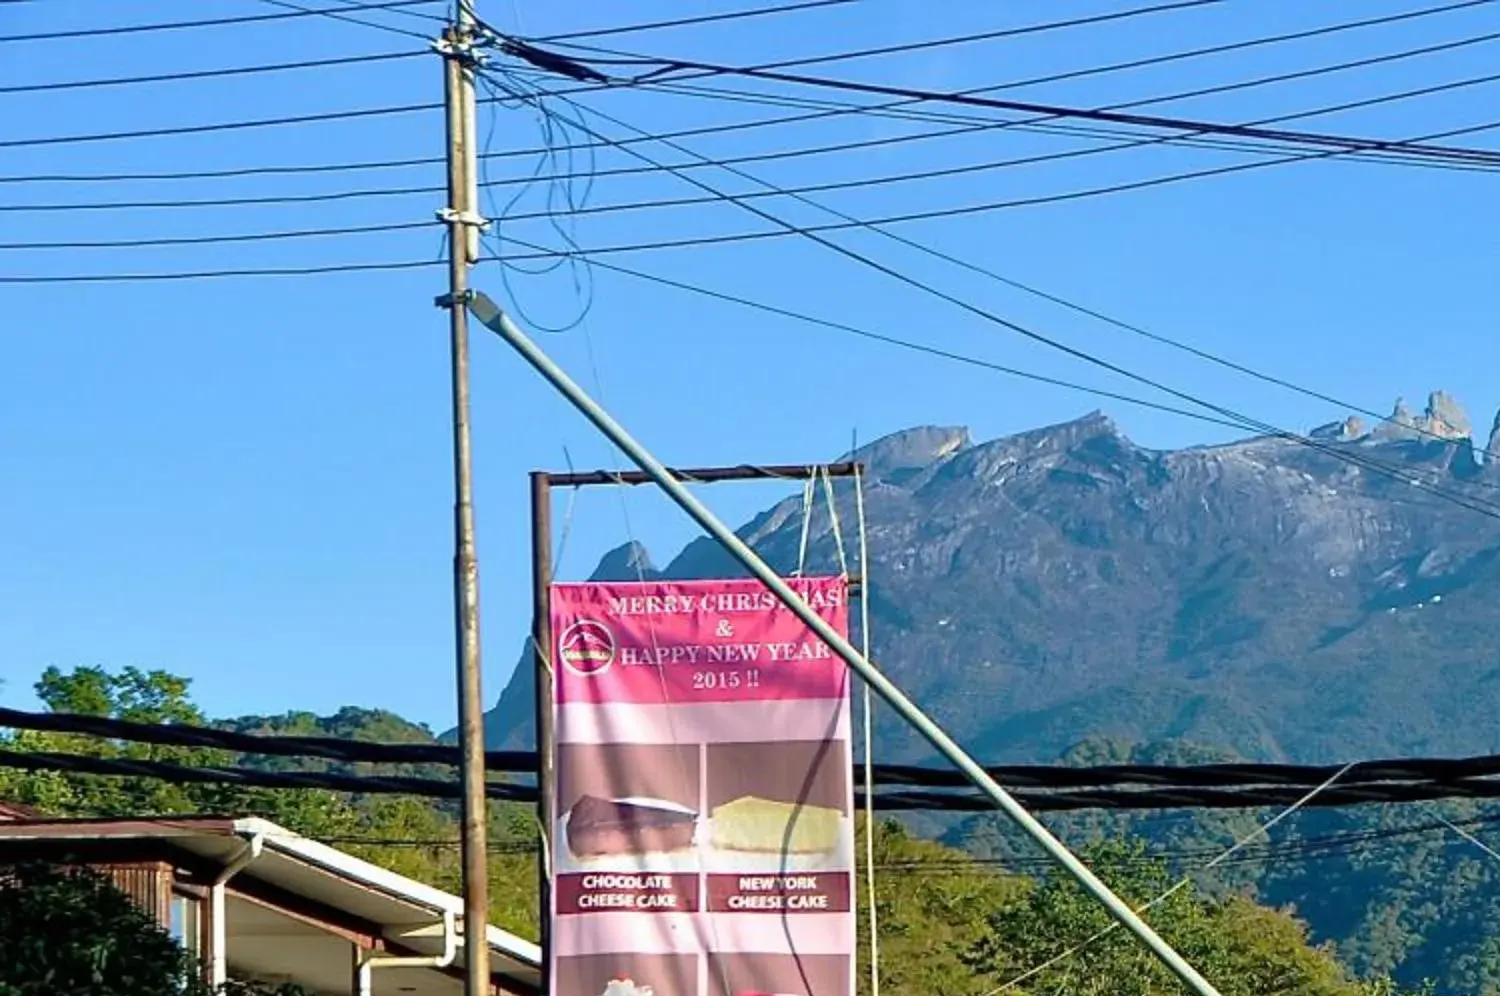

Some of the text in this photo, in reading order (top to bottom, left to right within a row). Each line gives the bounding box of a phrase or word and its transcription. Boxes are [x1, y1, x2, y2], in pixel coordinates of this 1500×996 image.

[608, 586, 842, 616] MERRY CHRISAS
[715, 619, 734, 637] &
[620, 641, 832, 666] HAPPY NEW YEAR
[692, 670, 740, 689] 2015
[582, 875, 673, 890] CHOCOLATE
[739, 876, 817, 892] NEW YORK
[578, 893, 677, 908] CHEESE CAKE
[727, 895, 828, 909] CHEESE CAKE
